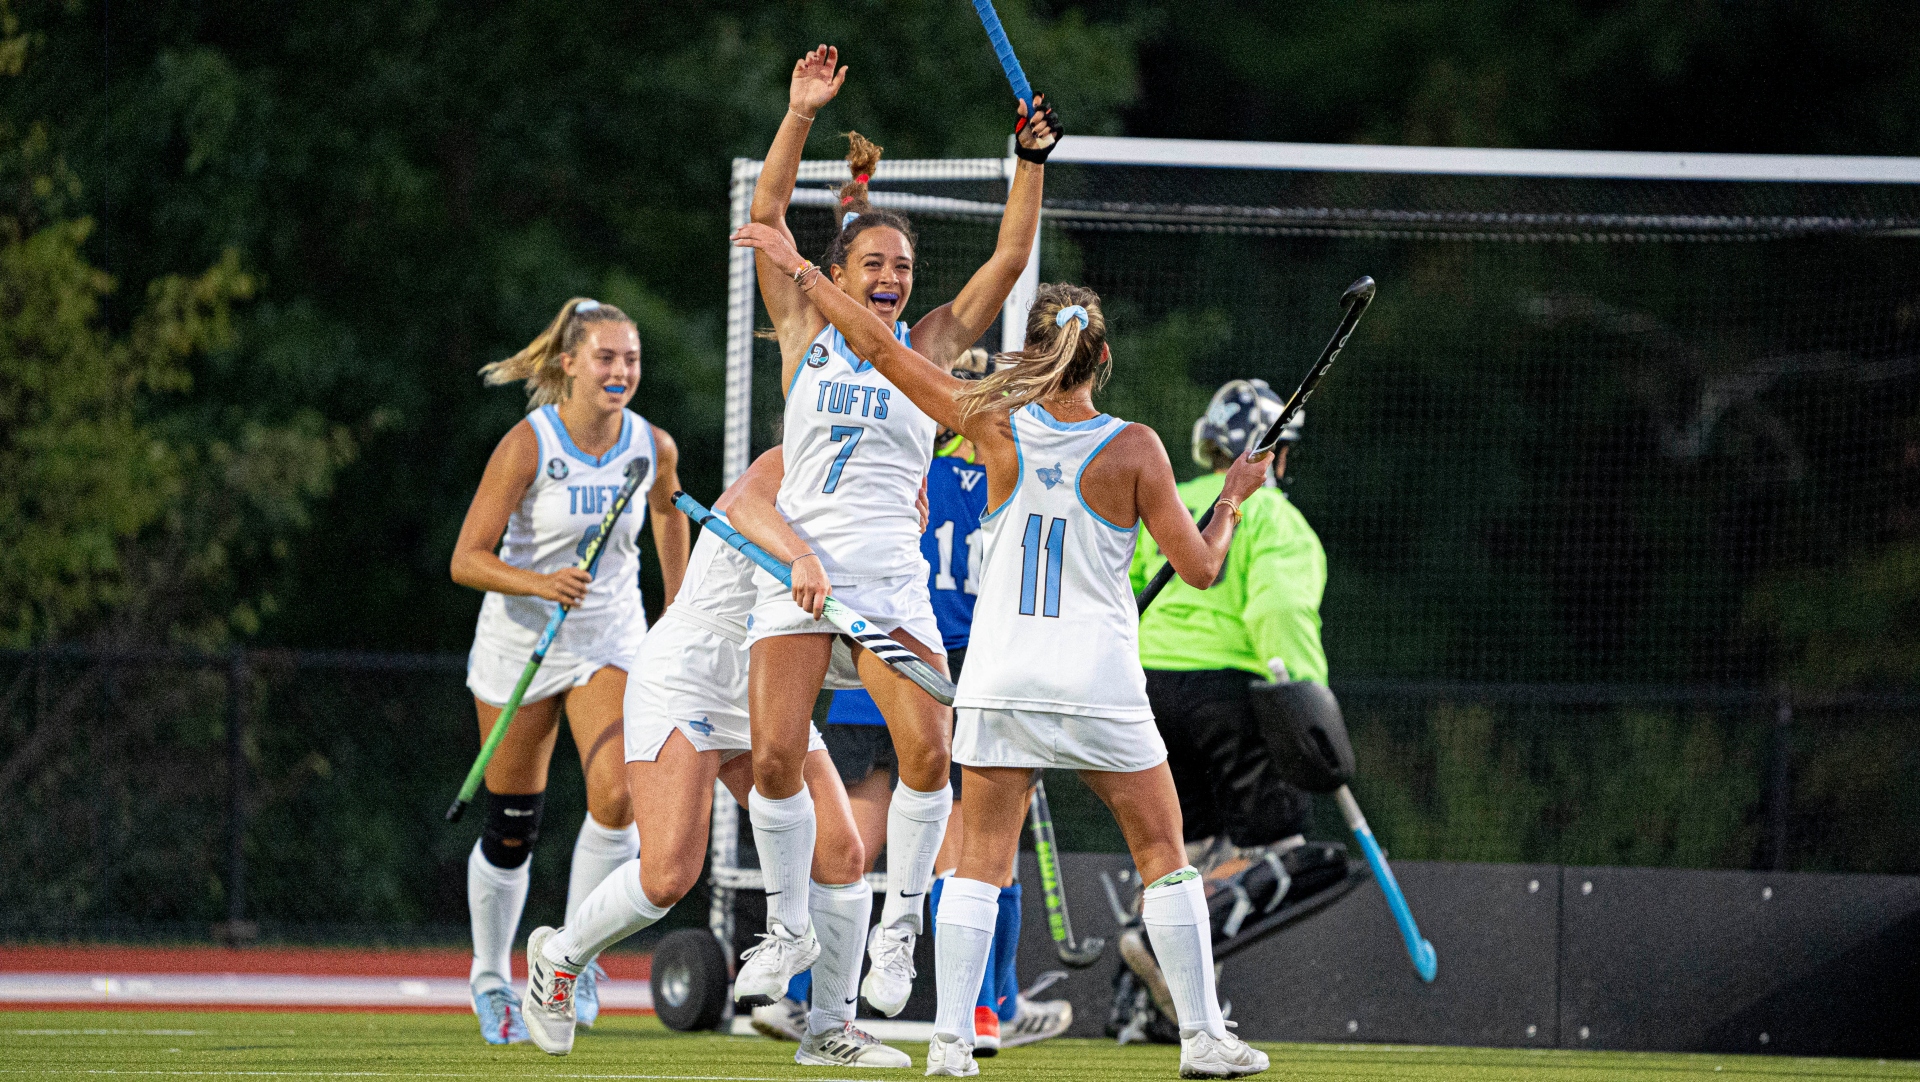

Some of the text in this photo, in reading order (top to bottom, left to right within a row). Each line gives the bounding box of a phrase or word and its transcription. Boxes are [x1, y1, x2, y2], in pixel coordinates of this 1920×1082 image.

[816, 380, 891, 420] TUFTS
[822, 425, 864, 494] 7
[952, 466, 985, 492] W
[567, 485, 633, 515] TUFT
[1019, 513, 1067, 619] 11
